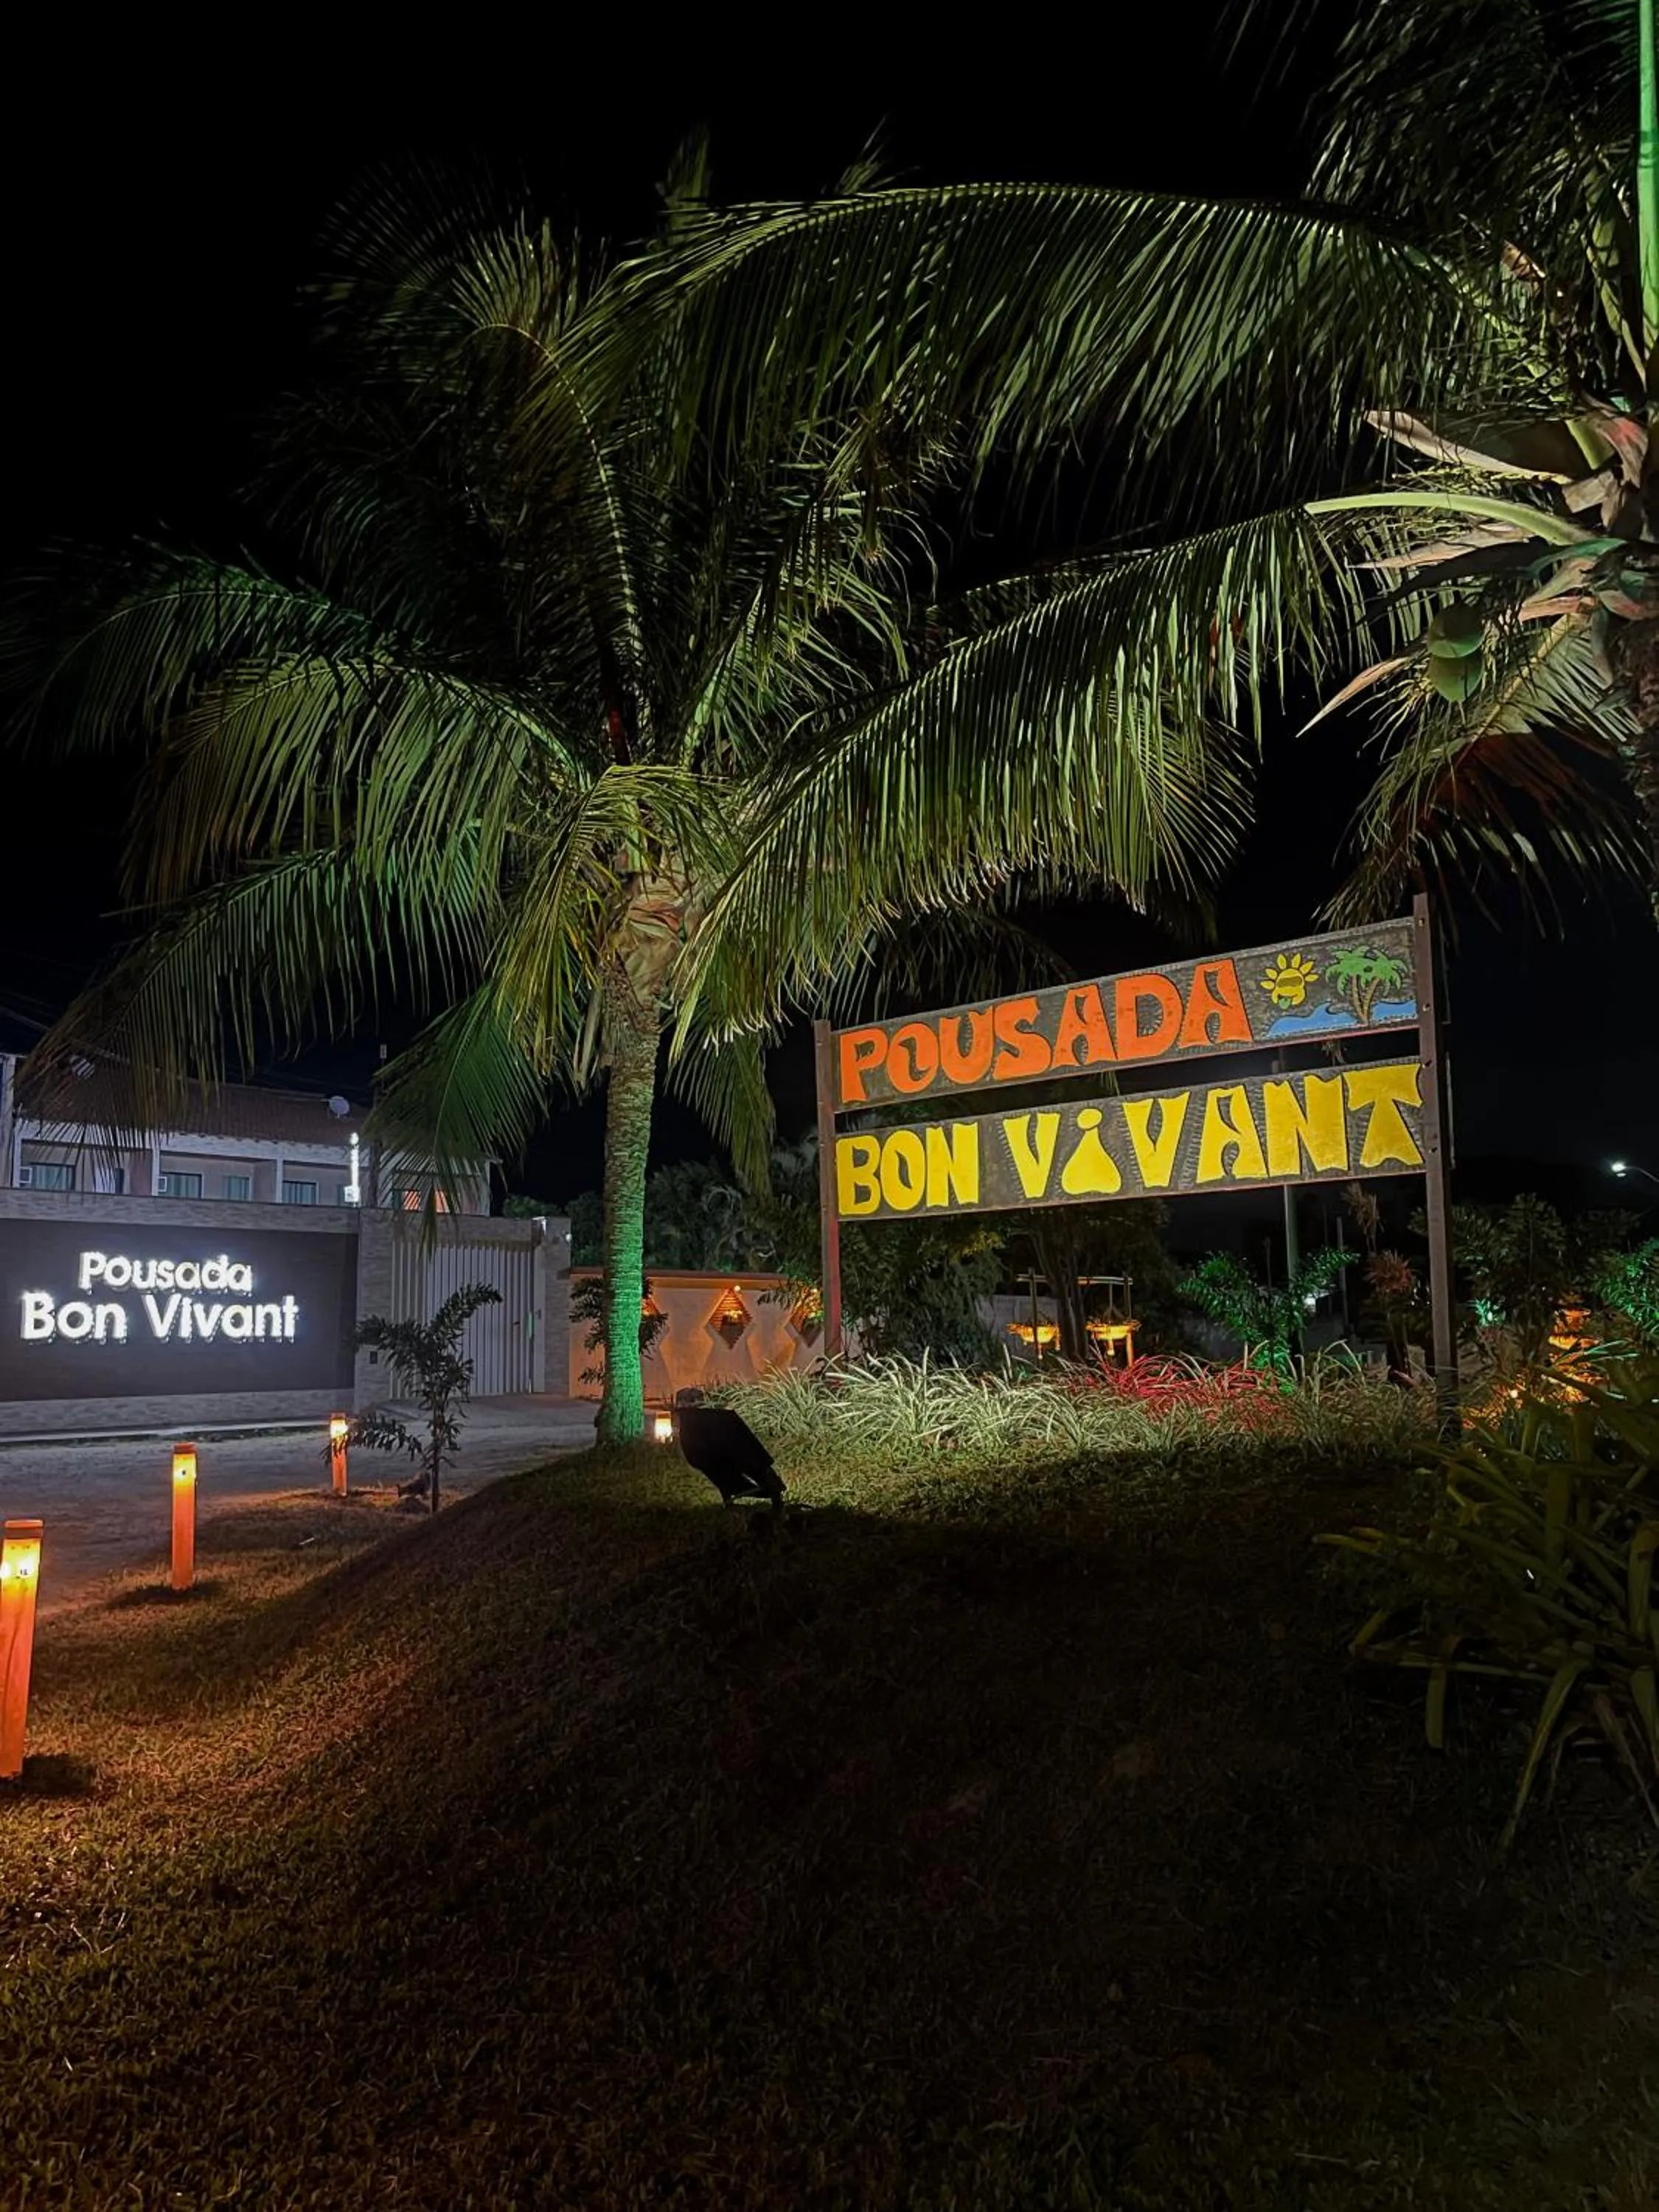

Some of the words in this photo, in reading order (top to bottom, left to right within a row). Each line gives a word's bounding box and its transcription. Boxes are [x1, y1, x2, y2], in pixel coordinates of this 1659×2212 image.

[839, 959, 1255, 1103] POUSADA
[835, 1121, 980, 1217] BON
[77, 1251, 255, 1292] Pousada
[21, 1290, 129, 1340] Bon
[142, 1293, 299, 1340] Vivant
